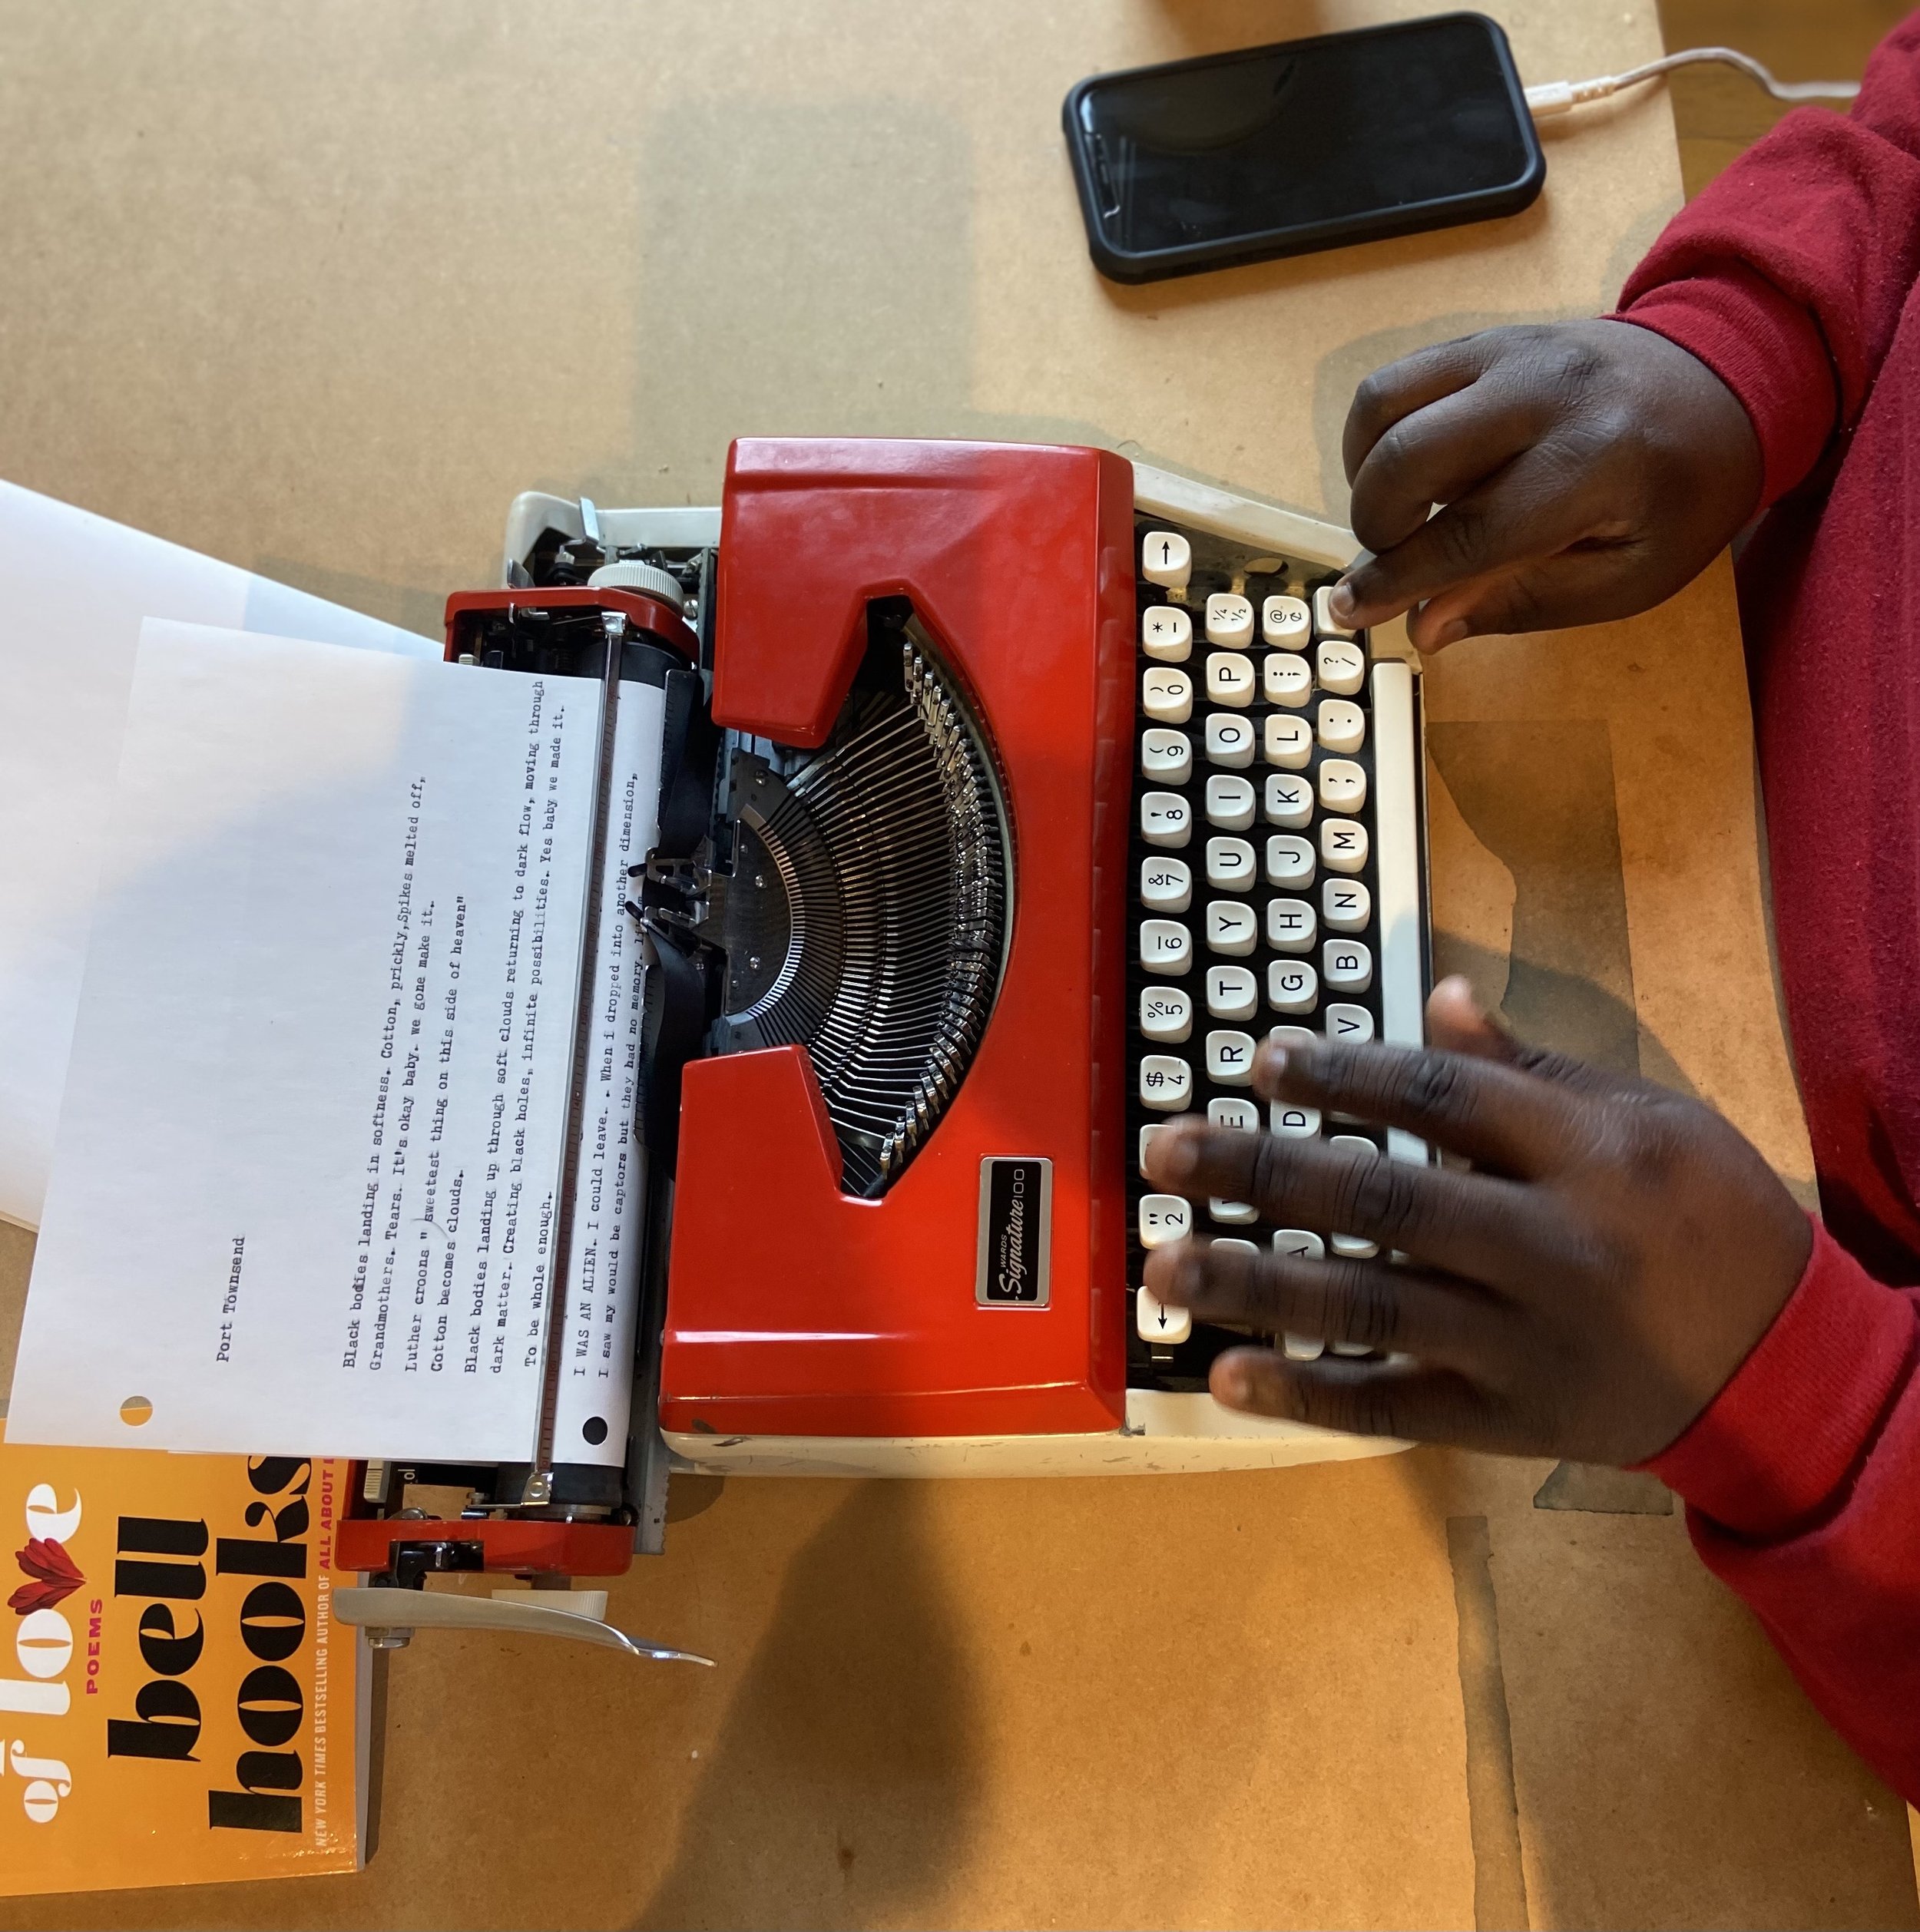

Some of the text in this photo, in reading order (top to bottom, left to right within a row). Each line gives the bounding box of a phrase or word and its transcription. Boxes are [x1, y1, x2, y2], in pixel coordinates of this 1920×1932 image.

[1270, 610, 1286, 623] @
[1219, 667, 1240, 681] P
[552, 706, 564, 729] it.
[1167, 746, 1183, 756] 9
[1276, 730, 1298, 741] L
[550, 738, 561, 768] made
[411, 777, 425, 808] off,
[549, 777, 558, 791] we
[1277, 789, 1299, 802] K
[542, 799, 558, 830] baby
[1166, 809, 1183, 820] 8
[405, 817, 419, 866] melted
[540, 839, 552, 862] Yes
[1333, 832, 1355, 849] M
[1220, 852, 1242, 866] U
[1279, 851, 1300, 863] J
[616, 859, 628, 915] another
[1148, 874, 1164, 885] &
[1166, 874, 1183, 885] 7
[1335, 893, 1356, 908] N
[450, 896, 465, 954] heaven"
[1219, 916, 1242, 931] Y
[1279, 914, 1302, 928] H
[418, 936, 430, 968] make
[611, 925, 623, 957] into
[1165, 938, 1182, 948] 6
[449, 961, 460, 979] of
[1336, 955, 1358, 969] B
[414, 977, 425, 1011] gone
[605, 965, 621, 1022] dropped
[1220, 981, 1243, 996] T
[1281, 974, 1303, 991] G
[445, 989, 457, 1021] side
[1147, 1002, 1164, 1018] %
[1166, 1004, 1183, 1014] 5
[381, 999, 401, 1058] Cotton,
[411, 1019, 420, 1035] we
[465, 681, 545, 1373] Black bodies landing up through soft clouds returning to dark flow, moving through
[521, 993, 538, 1060] infinite
[604, 1031, 614, 1040] i
[629, 1019, 637, 1034] no
[1337, 1018, 1360, 1034] V
[439, 1030, 453, 1063] this
[624, 1044, 635, 1069] had
[1220, 1044, 1243, 1062] R
[402, 1044, 419, 1086] baby.
[601, 1047, 613, 1081] When
[1146, 1072, 1164, 1087] $
[1167, 1075, 1185, 1084] 4
[439, 1072, 449, 1090] on
[621, 1077, 634, 1109] they
[399, 1097, 414, 1131] okay
[430, 1098, 448, 1142] thing
[1220, 1114, 1243, 1130] E
[1283, 1110, 1306, 1126] D
[593, 1107, 608, 1160] leave.
[617, 1121, 628, 1144] but
[367, 1153, 379, 1173] in
[392, 1137, 408, 1176] It's
[510, 1127, 525, 1173] black
[423, 1150, 439, 1222] sweetest
[591, 1168, 602, 1212] could
[614, 1153, 627, 1214] captors
[358, 1183, 379, 1246] landing
[385, 1184, 402, 1239] Tears.
[503, 1179, 522, 1253] Creating
[1165, 1213, 1183, 1225] 2
[610, 1226, 620, 1240] be
[998, 1198, 1028, 1294] Signature
[415, 1250, 429, 1305] croons
[431, 1169, 464, 1371] Cotton becomes clouds.
[583, 1239, 597, 1293] ALIEN.
[608, 1250, 618, 1295] would
[349, 1254, 368, 1310] bodies
[497, 1262, 512, 1327] matter.
[531, 1265, 545, 1309] whole
[217, 1236, 245, 1362] Port Townsend
[369, 1248, 396, 1370] Grandmothers.
[580, 1302, 591, 1321] AN
[605, 1305, 615, 1323] my
[405, 1315, 422, 1371] Luther
[527, 1319, 539, 1336] be
[343, 1319, 360, 1368] Black
[490, 1335, 505, 1373] dark
[525, 1345, 537, 1367] To
[576, 1330, 589, 1357] WAS
[319, 1471, 333, 1530] ABOUT
[319, 1536, 331, 1570] ALL
[318, 1575, 330, 1589] OF
[316, 1593, 330, 1644] AUTHOR
[86, 1599, 102, 1694] POEMS
[107, 1516, 208, 1762] bell
[208, 1455, 312, 1833] hooks
[315, 1649, 329, 1733] BESTSELLING
[315, 1737, 328, 1775] TIMES
[10, 1739, 71, 1822] of
[316, 1781, 328, 1814] YORK
[316, 1817, 328, 1847] NEW
